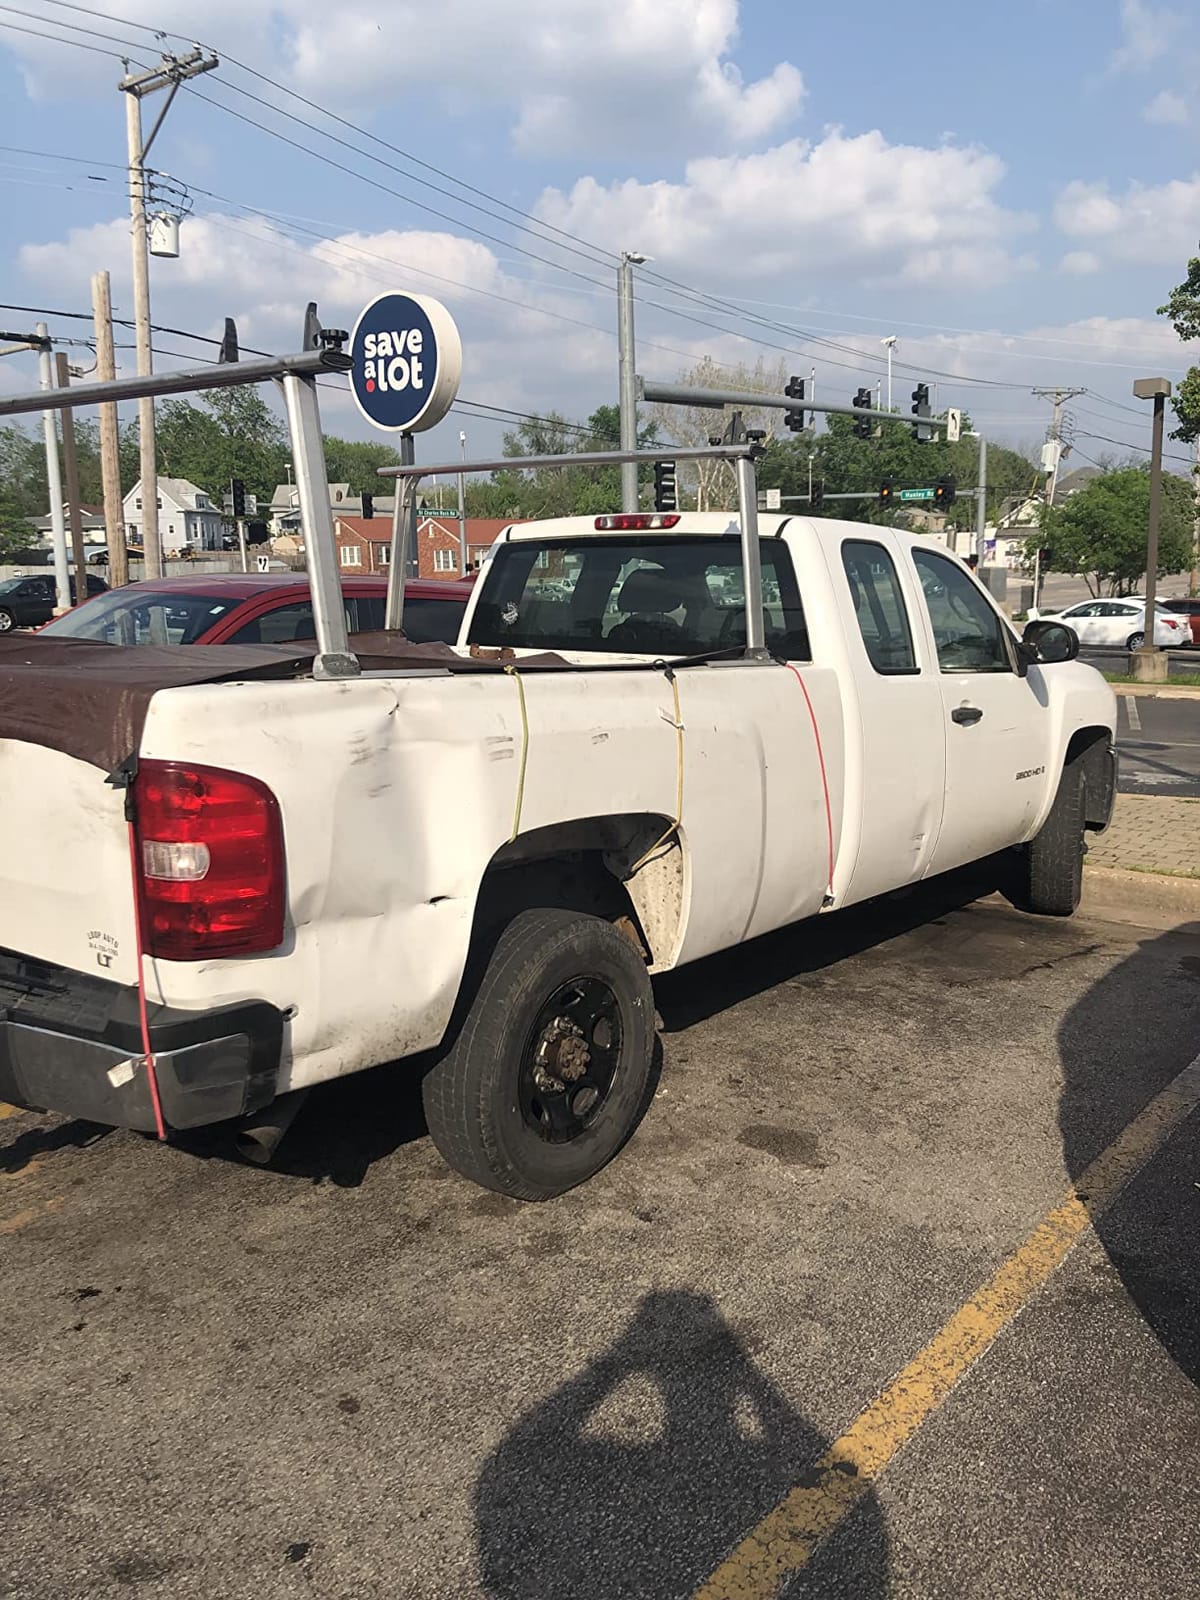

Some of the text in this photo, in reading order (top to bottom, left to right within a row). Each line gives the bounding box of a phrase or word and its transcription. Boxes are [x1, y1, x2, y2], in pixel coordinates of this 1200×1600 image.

[364, 328, 423, 358] save
[364, 360, 376, 378] a
[97, 952, 112, 969] LT
